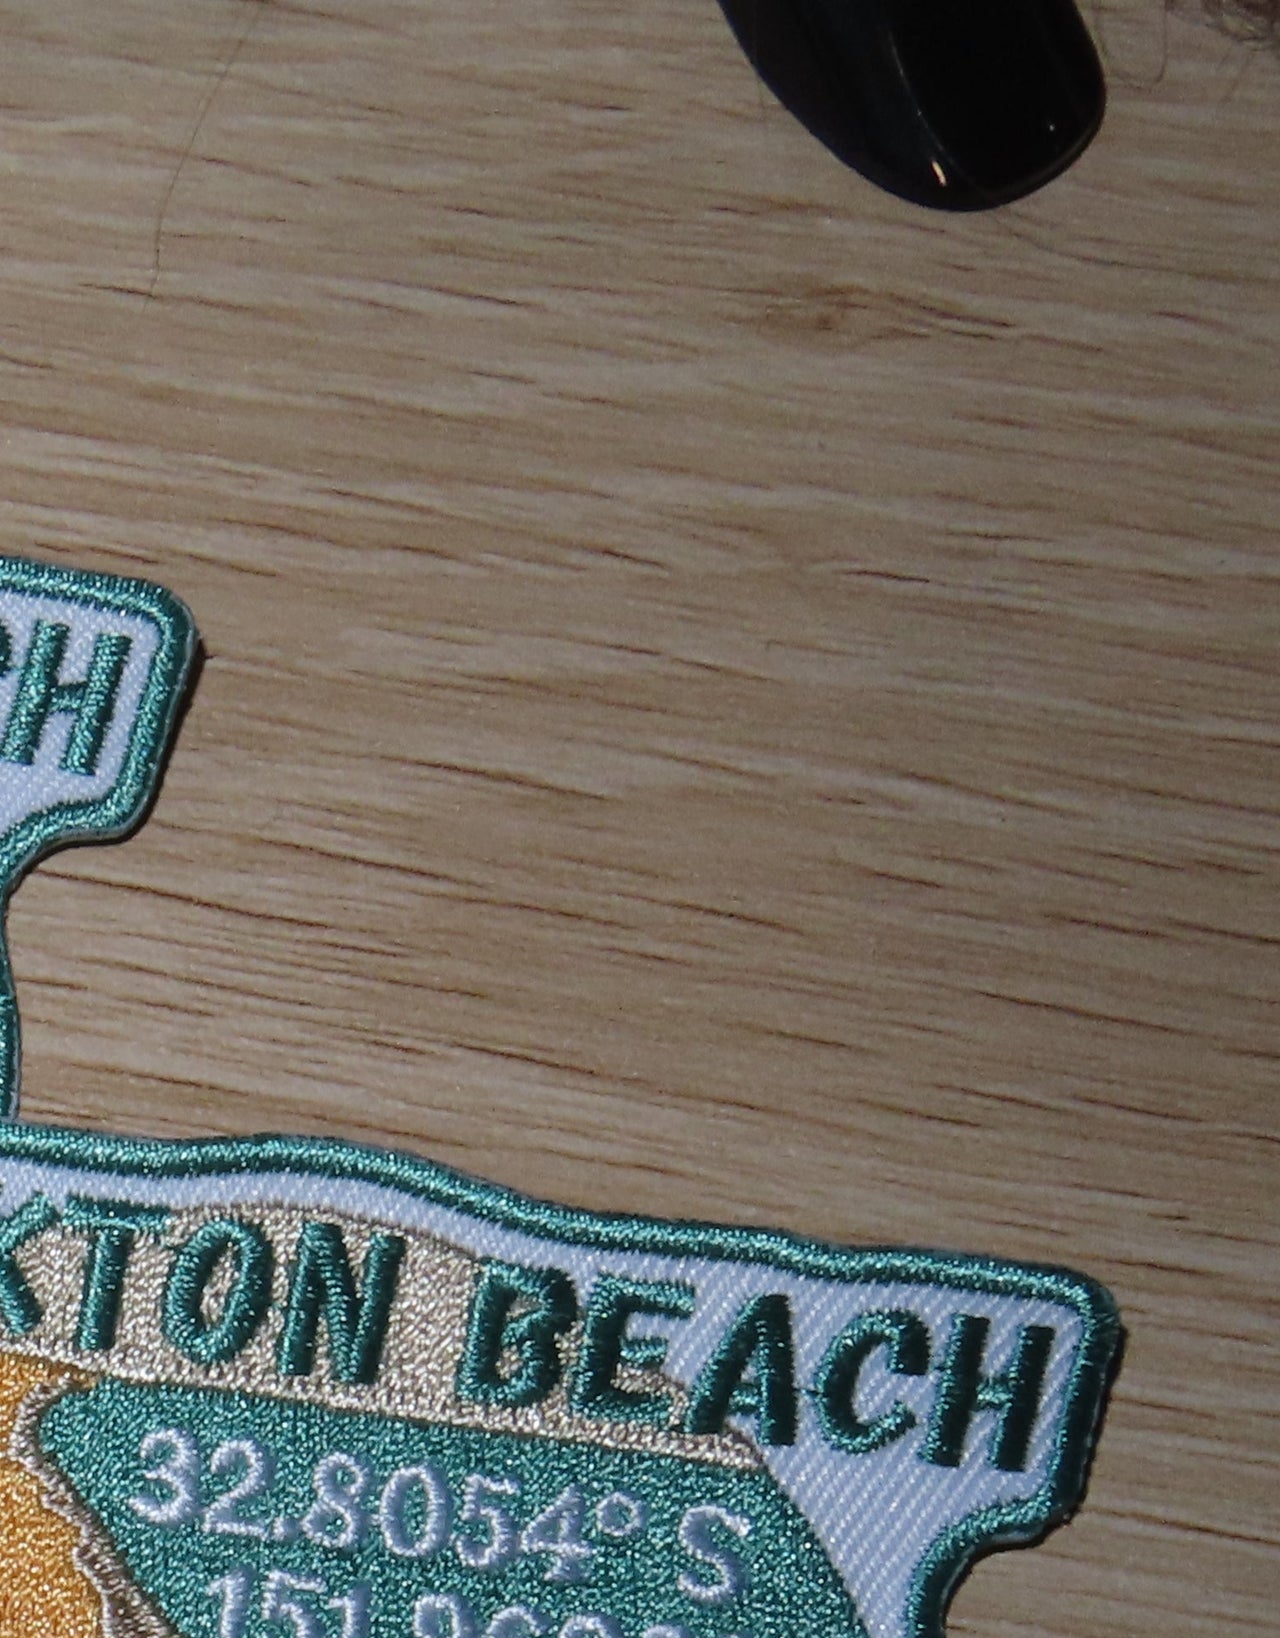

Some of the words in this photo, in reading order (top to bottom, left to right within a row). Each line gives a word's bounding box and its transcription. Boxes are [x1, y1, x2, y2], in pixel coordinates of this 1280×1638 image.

[463, 1263, 1052, 1469] BEACH
[133, 1431, 638, 1578] 32.8054°
[677, 1505, 752, 1602] S
